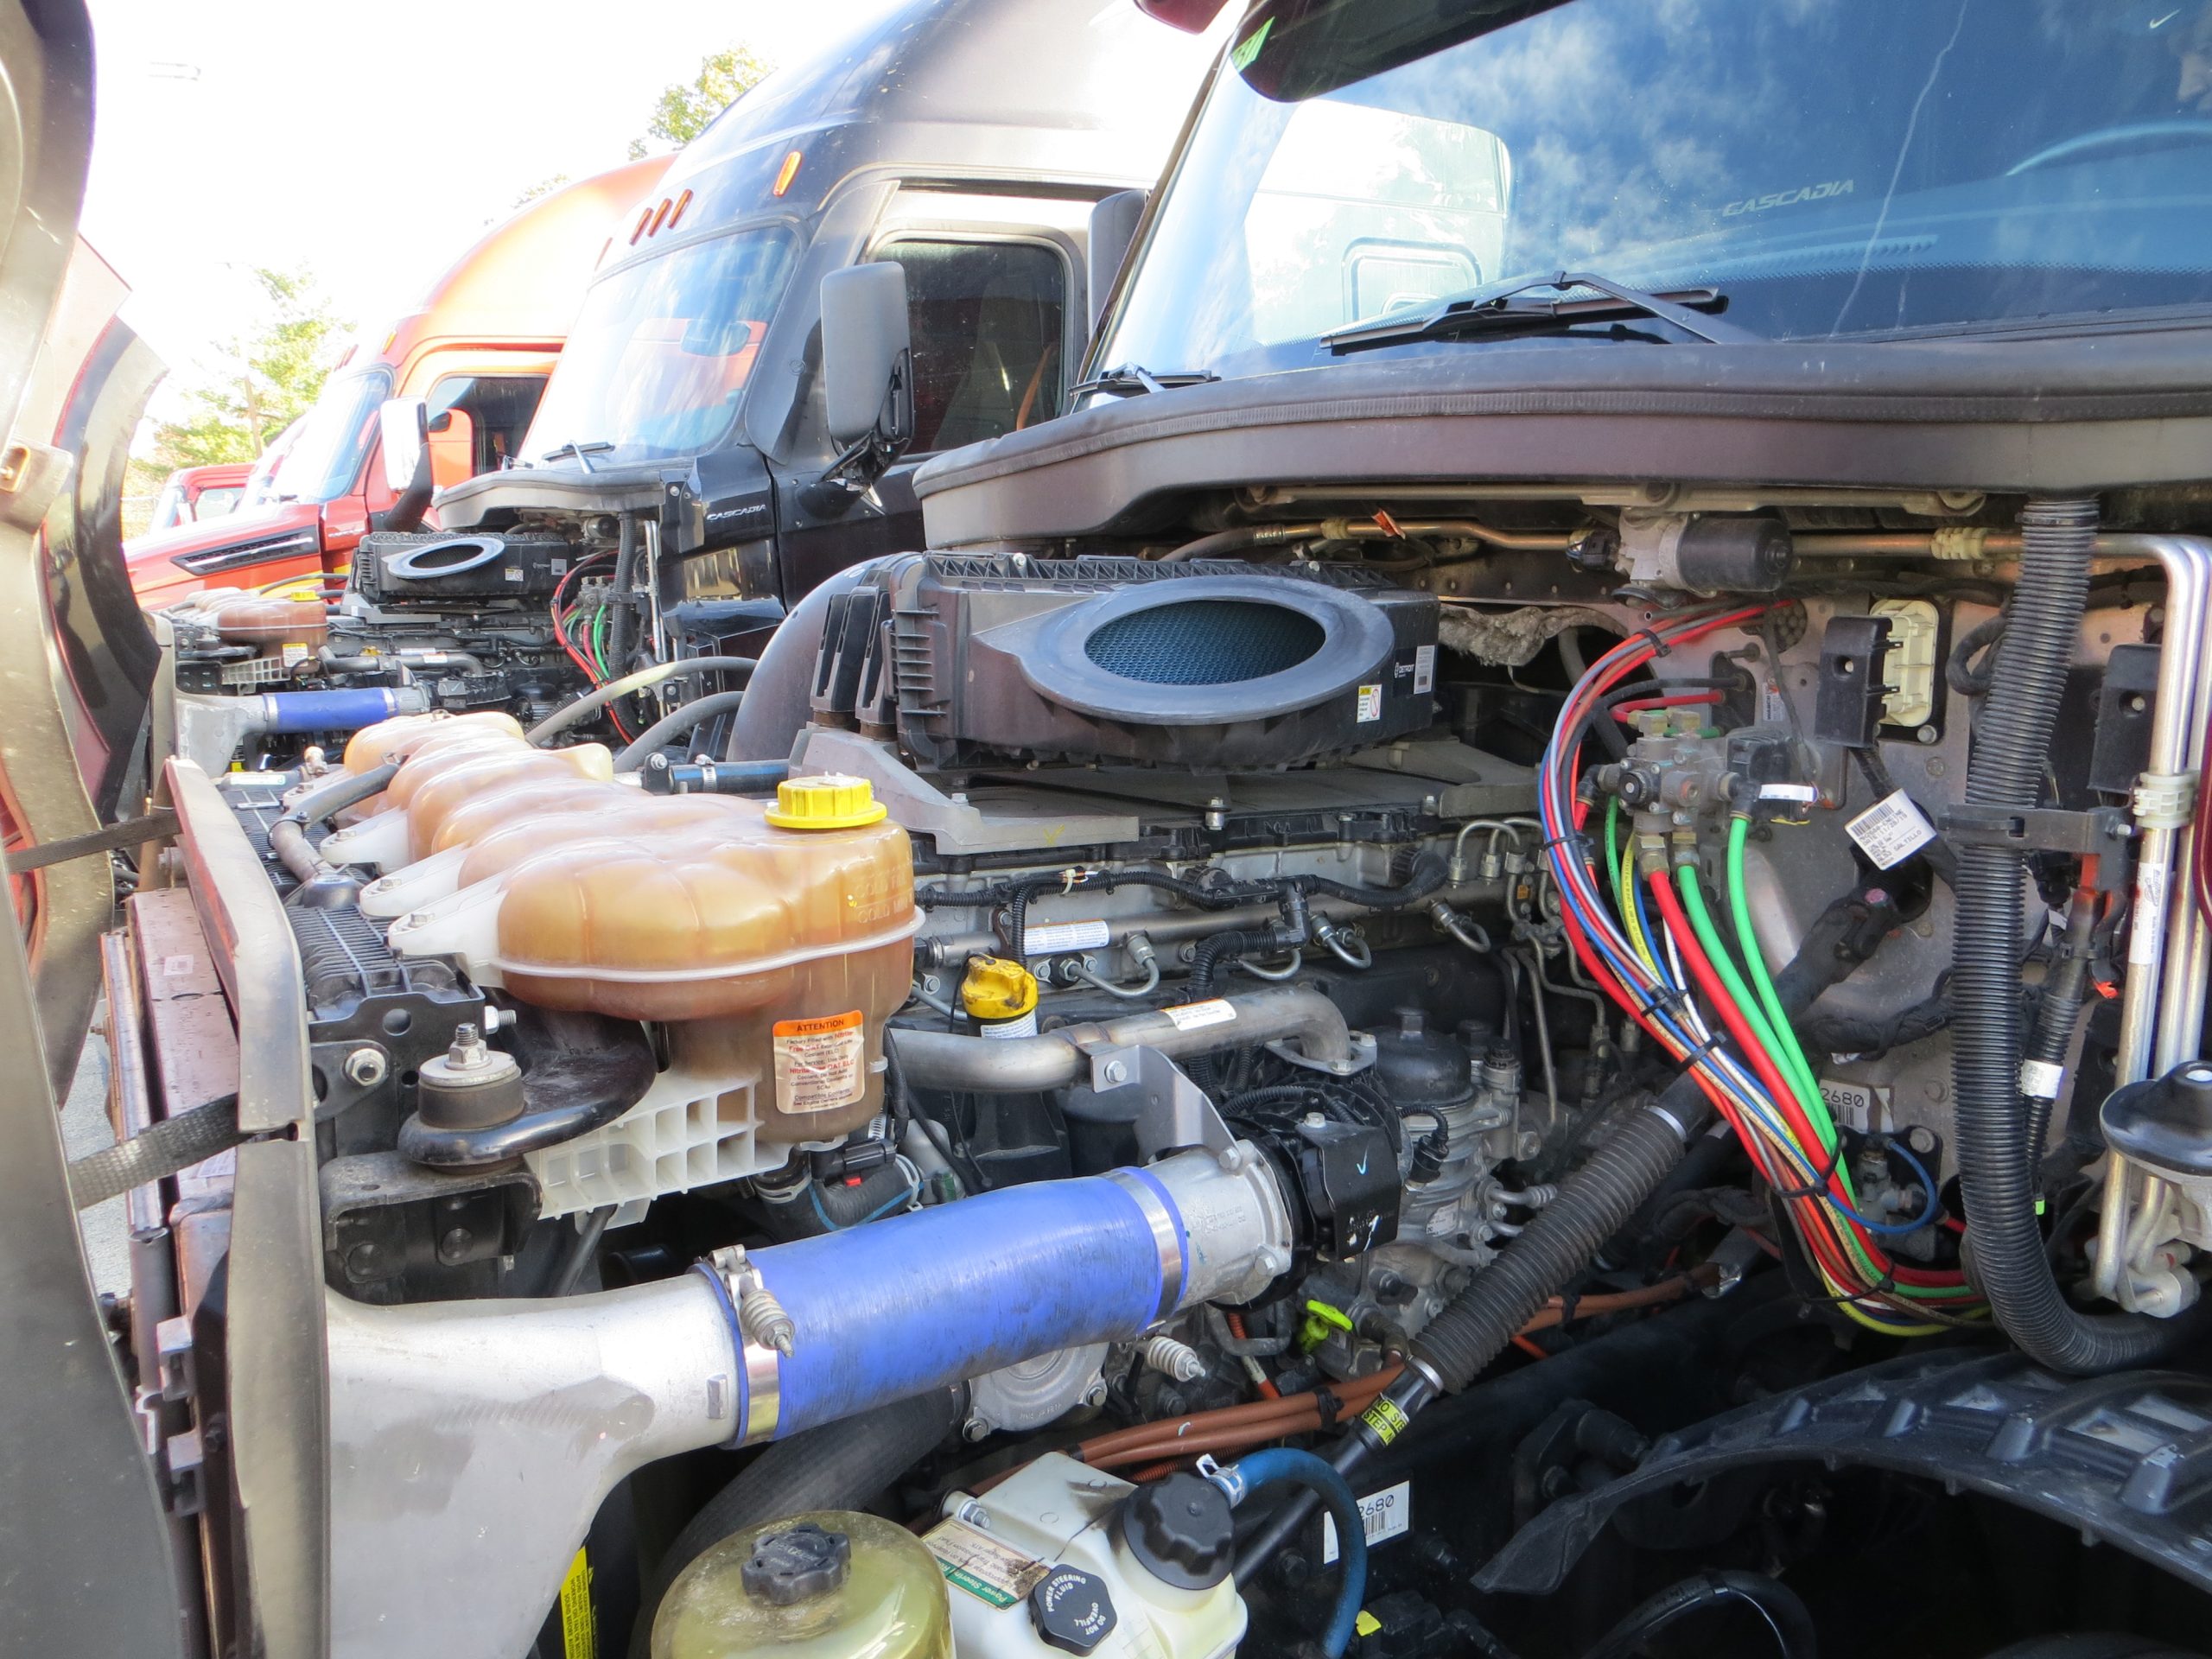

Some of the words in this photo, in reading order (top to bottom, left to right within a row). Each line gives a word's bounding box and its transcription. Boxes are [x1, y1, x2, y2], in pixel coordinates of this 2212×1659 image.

[1722, 180, 1853, 217] CASCADIA
[707, 504, 766, 520] CASCADIA
[858, 904, 890, 923] COLD
[797, 1019, 843, 1032] ATTENTION
[1363, 1410, 1387, 1431] STEP
[1375, 1401, 1389, 1412] NO
[1391, 1413, 1405, 1431] STE
[949, 1567, 982, 1588] Steerin
[982, 1586, 1007, 1603] Power
[1046, 1586, 1055, 1612] POWER
[1052, 1574, 1086, 1587] STEERING
[1054, 1583, 1073, 1600] FLUID
[1073, 1602, 1099, 1626] OVERFILL
[1097, 1615, 1106, 1626] DO
[1085, 1624, 1099, 1635] NOT
